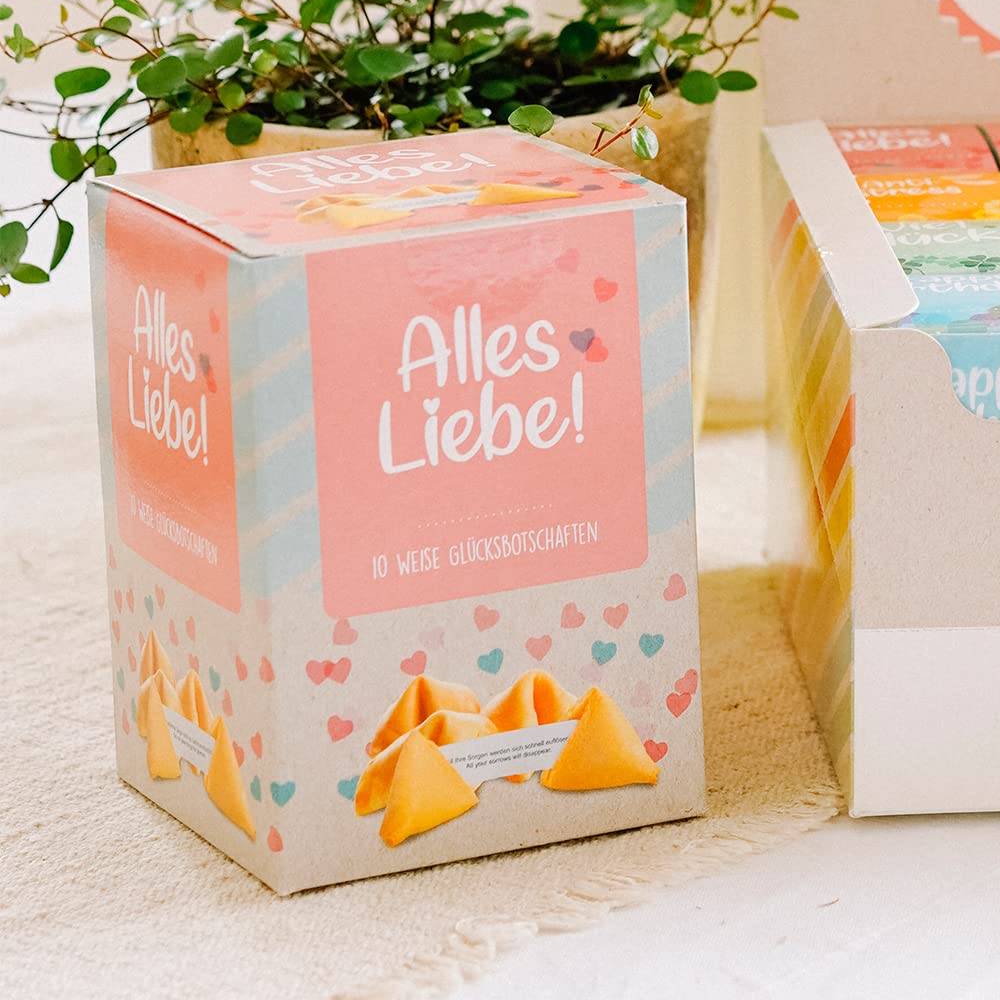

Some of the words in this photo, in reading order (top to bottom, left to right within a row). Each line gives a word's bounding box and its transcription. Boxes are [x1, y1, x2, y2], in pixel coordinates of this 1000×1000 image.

[251, 149, 436, 179] Alles
[251, 153, 497, 194] Liebe!
[840, 133, 951, 152] iebe!
[134, 284, 197, 383] Alles
[397, 303, 561, 392] Alles
[128, 355, 209, 467] Liebe!
[378, 371, 585, 475] Liebe!
[372, 554, 388, 579] 10
[396, 547, 440, 576] WEISE
[449, 520, 599, 567] GLÜCKSBOTSCHAFTEN
